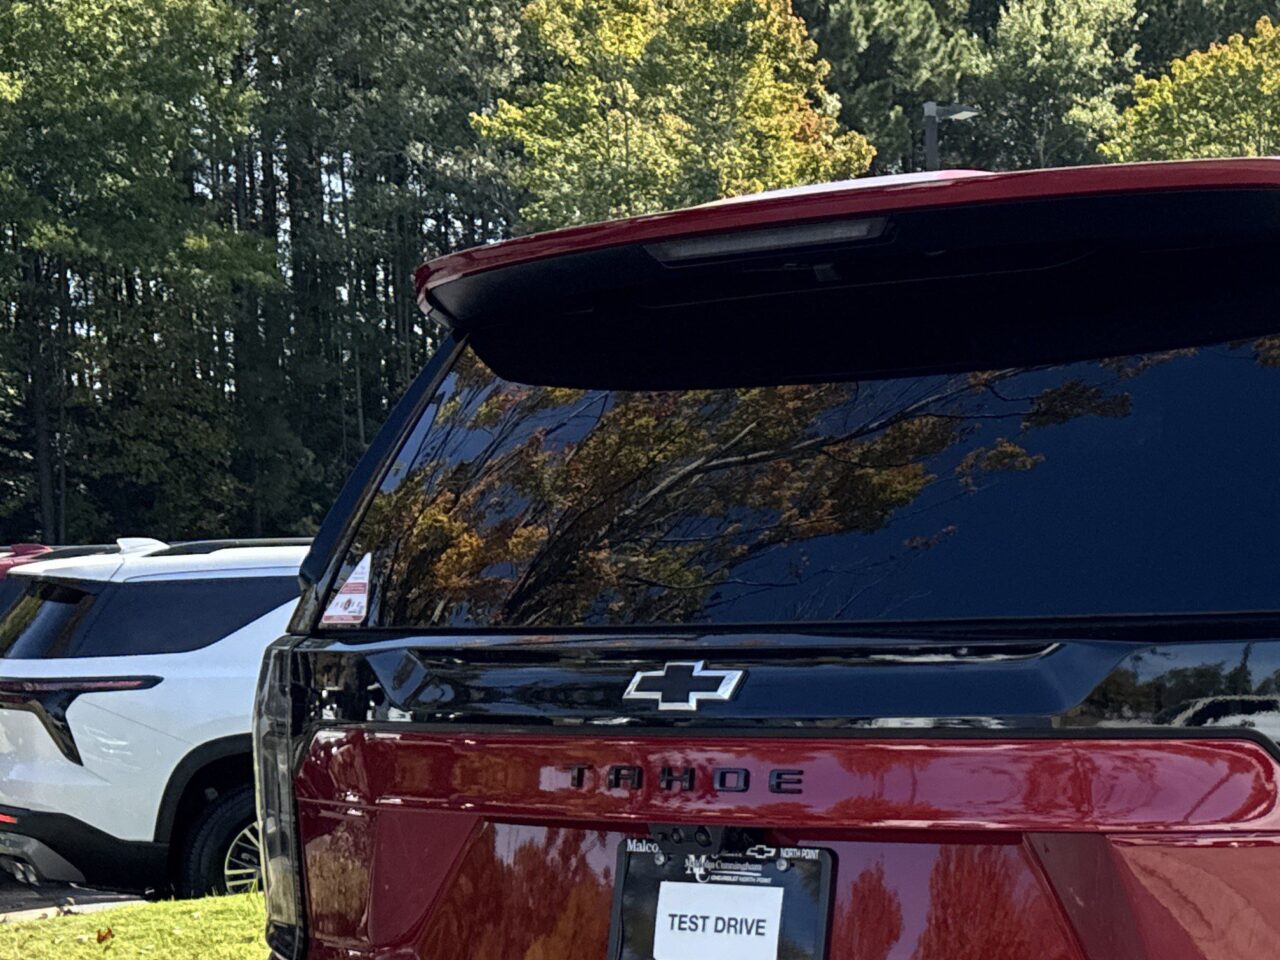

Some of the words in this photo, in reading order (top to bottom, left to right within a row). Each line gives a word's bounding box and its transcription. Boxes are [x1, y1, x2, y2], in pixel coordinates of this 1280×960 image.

[569, 764, 804, 793] TAHOE
[626, 838, 661, 853] Malco
[801, 848, 820, 860] POINT
[715, 860, 763, 872] Cunningham
[668, 913, 710, 933] TEST
[713, 916, 767, 936] DRIVE
